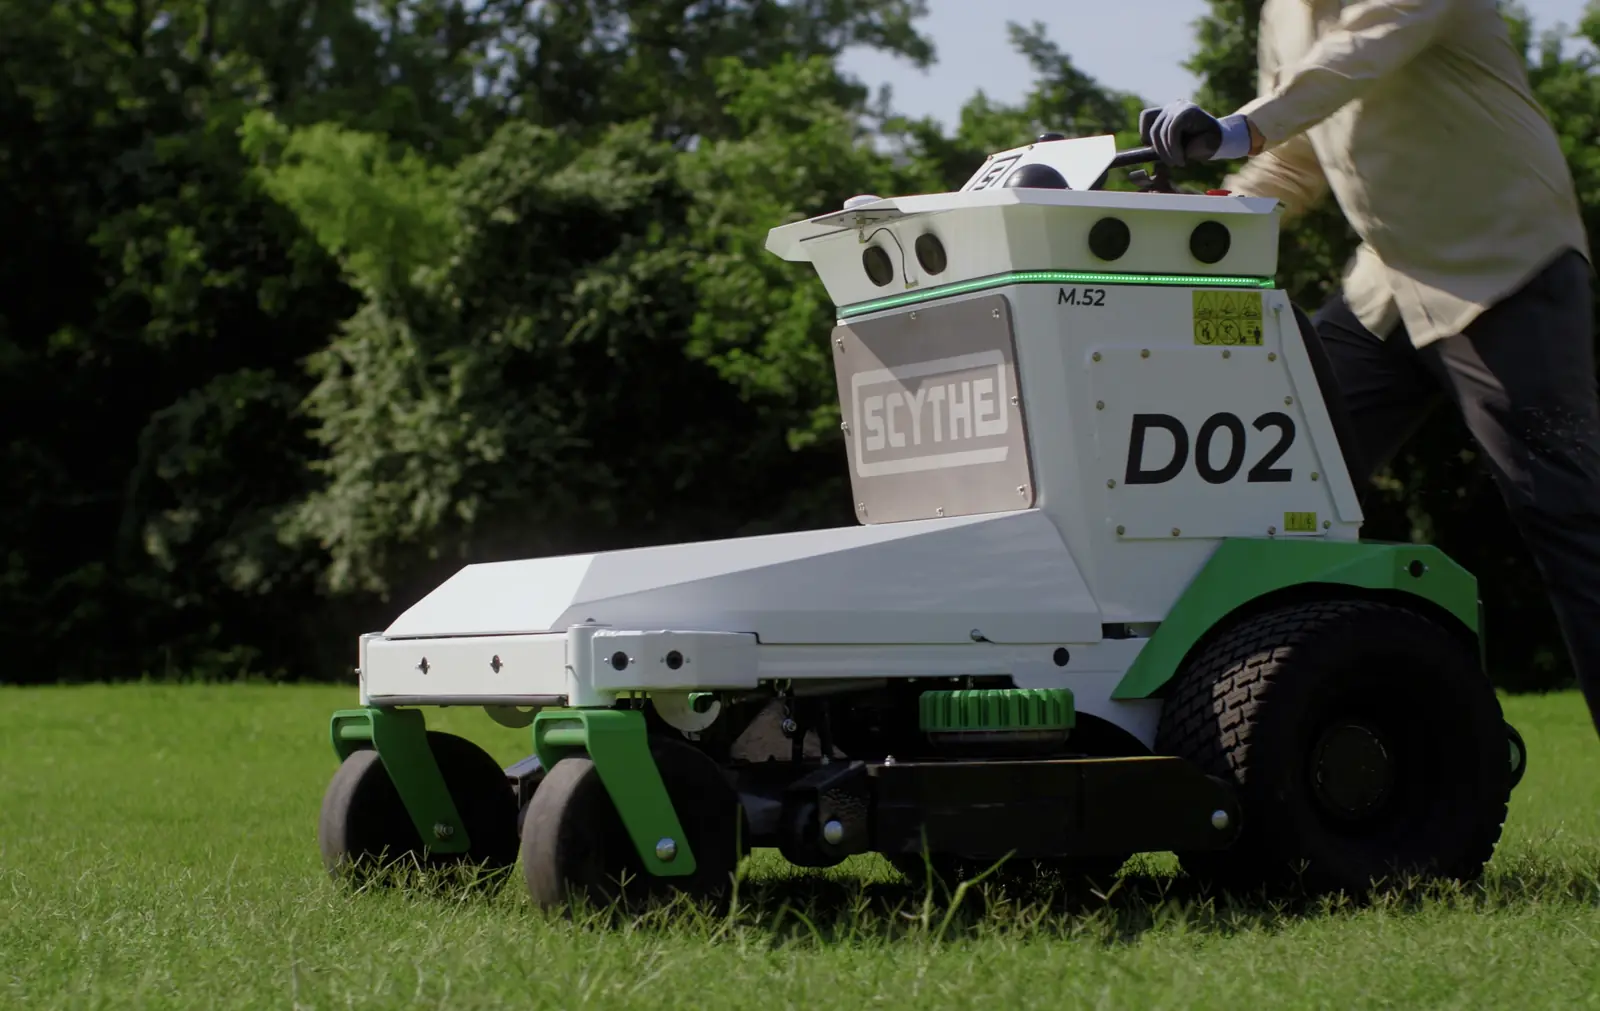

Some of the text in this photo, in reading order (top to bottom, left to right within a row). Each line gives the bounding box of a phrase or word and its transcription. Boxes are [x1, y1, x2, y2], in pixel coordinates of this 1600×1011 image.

[1057, 287, 1106, 307] M.52
[863, 378, 1000, 451] SCYTHE
[1124, 411, 1296, 484] D02
